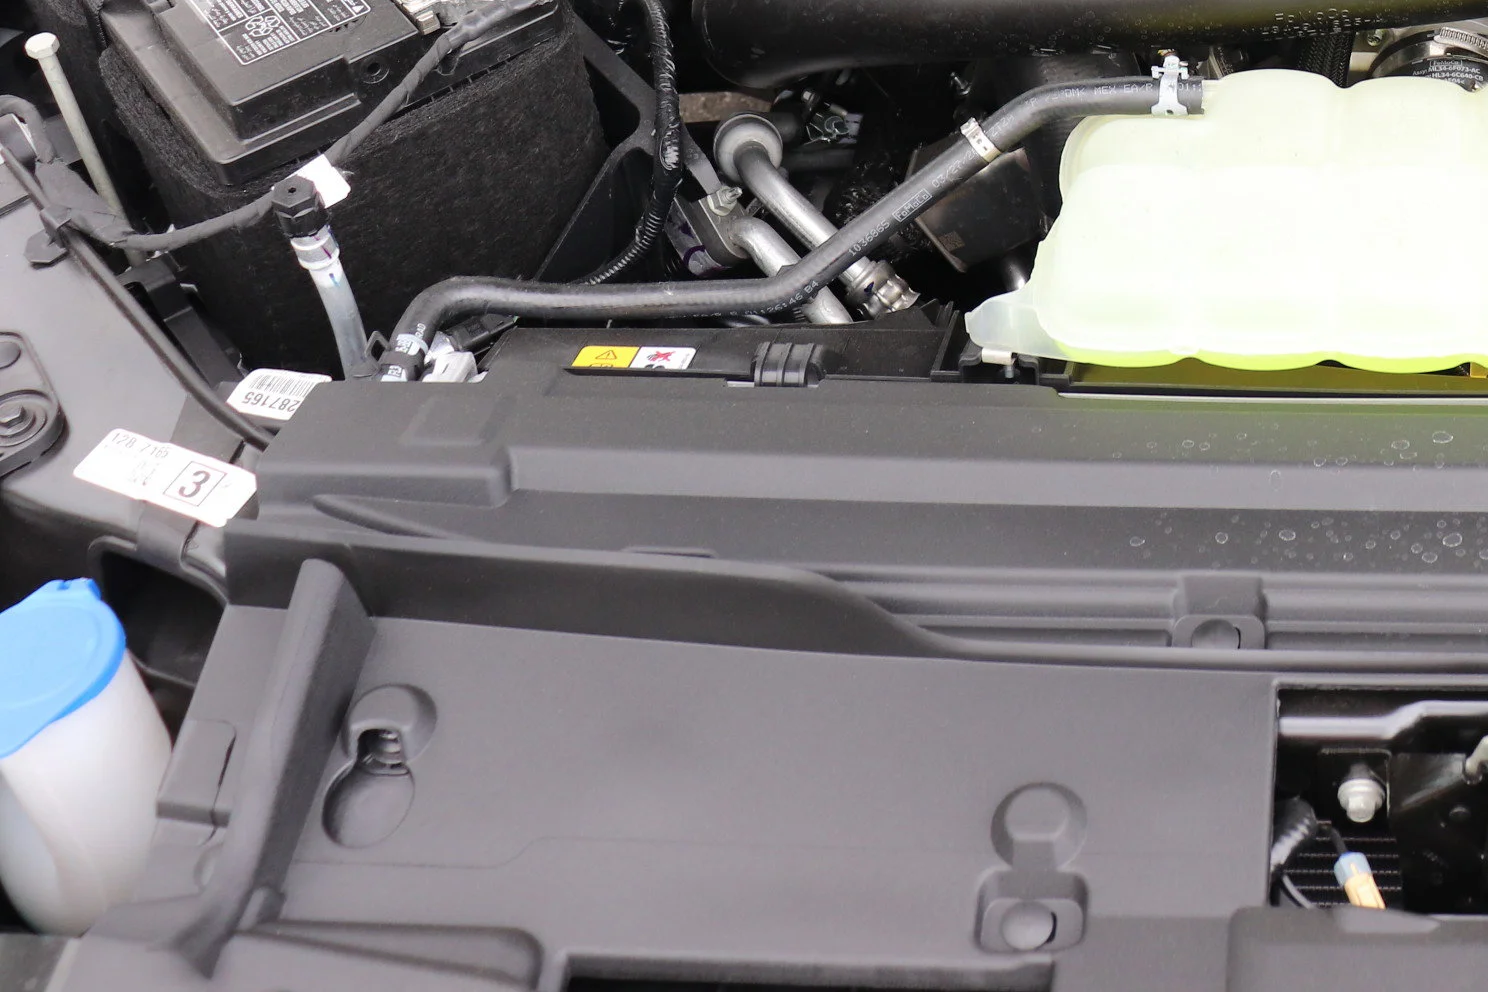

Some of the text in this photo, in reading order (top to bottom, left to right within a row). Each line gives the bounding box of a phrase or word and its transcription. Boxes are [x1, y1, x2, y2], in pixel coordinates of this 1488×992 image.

[804, 280, 819, 293] B4
[848, 219, 890, 256] 1036865
[896, 192, 930, 219] FoMoCo
[1093, 85, 1116, 95] MEX
[1123, 83, 1154, 93] EA/R
[177, 470, 211, 498] 3
